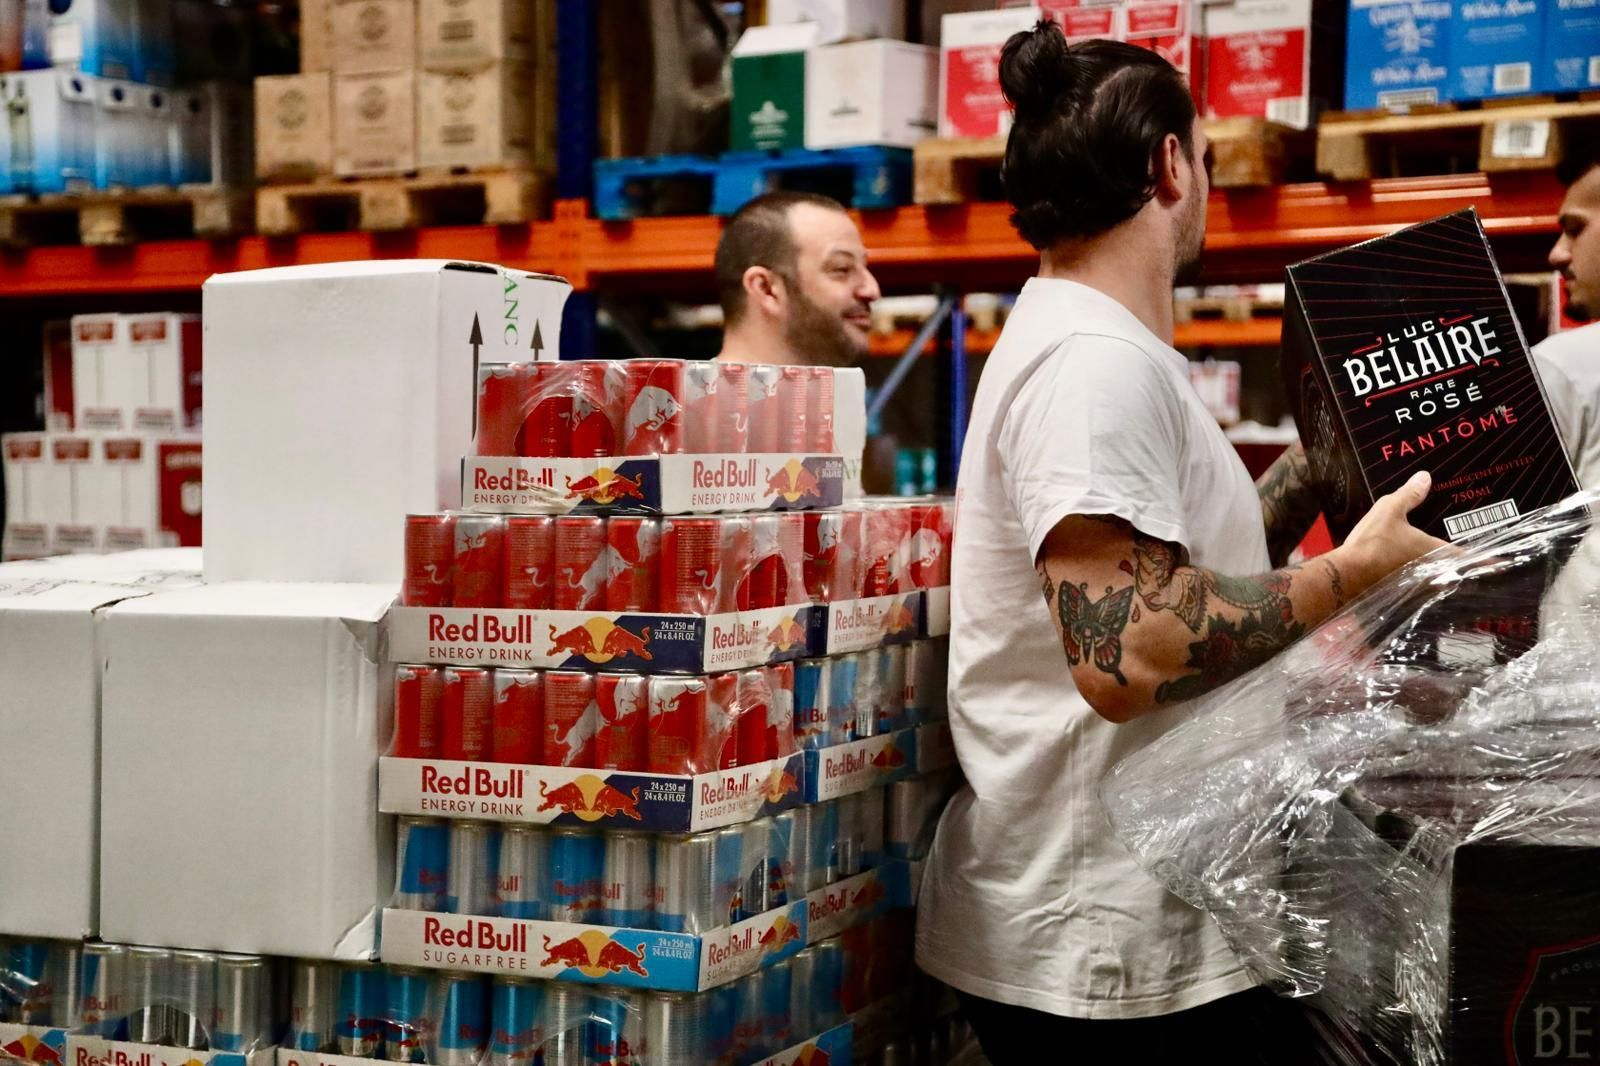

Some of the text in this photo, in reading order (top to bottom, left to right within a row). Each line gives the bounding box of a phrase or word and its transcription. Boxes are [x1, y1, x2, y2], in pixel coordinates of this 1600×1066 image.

[1387, 320, 1435, 344] LUC
[1343, 316, 1501, 397] BELAIRE
[1395, 383, 1483, 424] ROSÉ
[1410, 379, 1456, 400] RARE
[1381, 408, 1518, 462] FANTÔME
[474, 467, 513, 491] Red
[693, 458, 756, 488] Red Bull
[1432, 467, 1493, 493] UMINESCENT
[474, 493, 517, 504] ENERGY
[692, 492, 756, 505] ENERGY DRINK
[429, 613, 532, 644] Red Bull
[712, 623, 736, 650] Red
[429, 647, 533, 661] ENERGY DRINK
[825, 749, 865, 779] Red Bull
[421, 765, 523, 798] Red Bull
[701, 773, 749, 806] Red Bull
[421, 798, 524, 816] ENERGY DRINK
[808, 888, 847, 923] Red Bull
[424, 917, 526, 952] Red Bull
[423, 950, 527, 970] SUGARFREE
[708, 937, 732, 967] Red
[1533, 1002, 1593, 1058] BE
